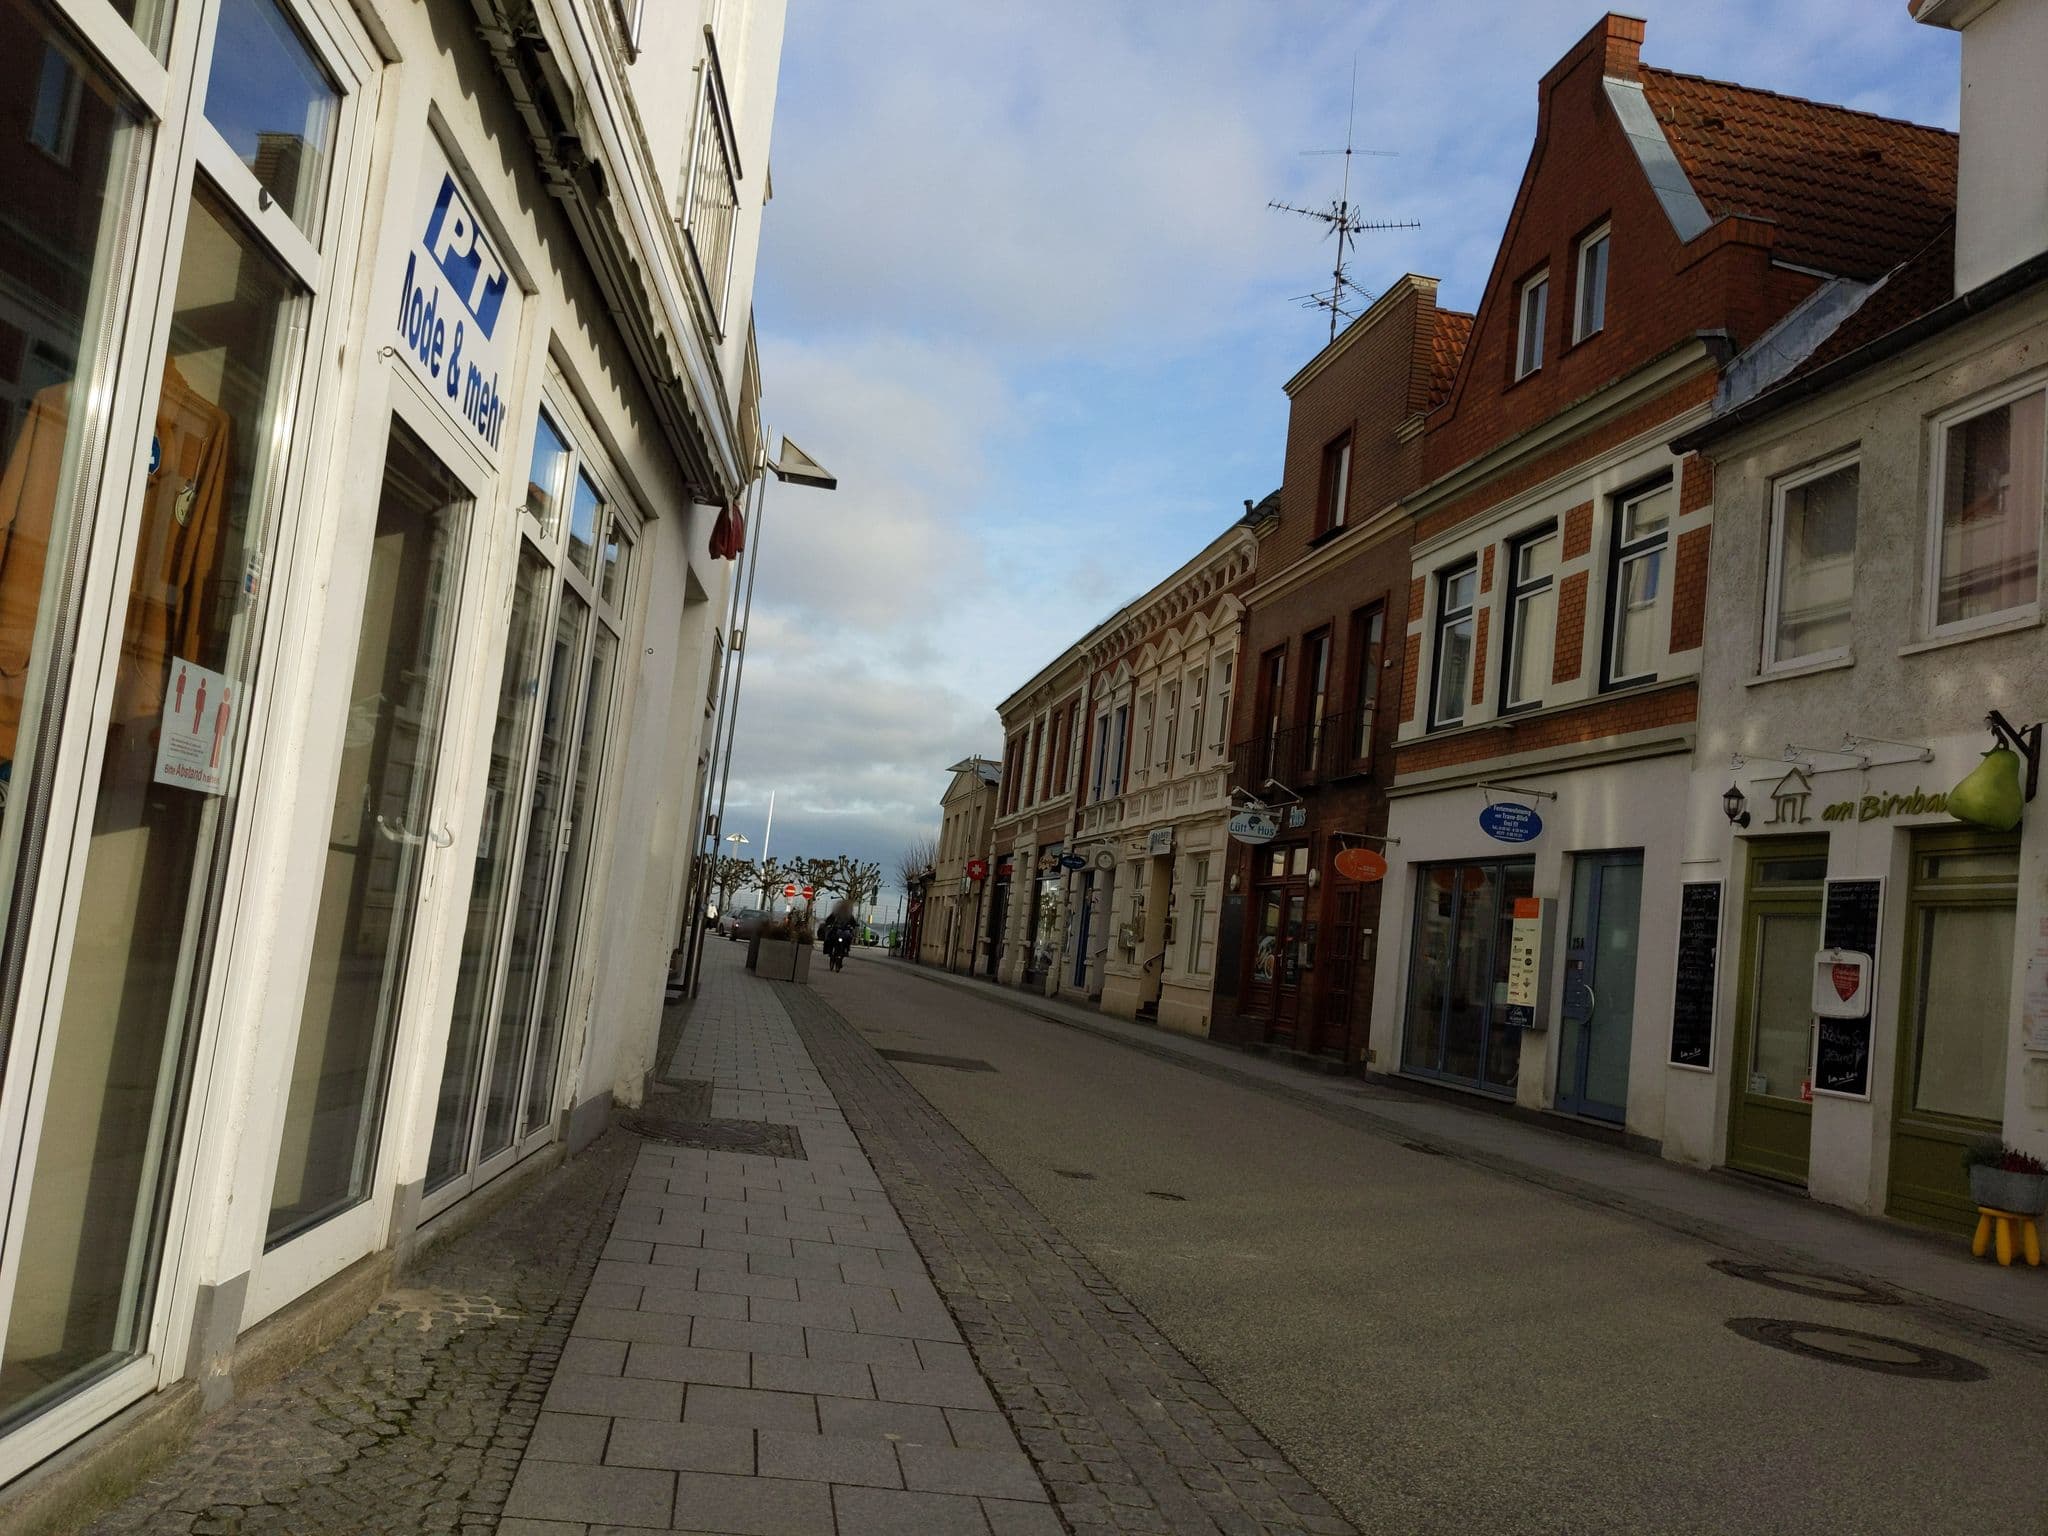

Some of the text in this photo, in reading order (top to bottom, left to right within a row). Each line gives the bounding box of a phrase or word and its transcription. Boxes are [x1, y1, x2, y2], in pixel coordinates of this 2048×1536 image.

[433, 190, 502, 316] PT
[446, 319, 464, 403] &
[463, 360, 506, 453] mehr
[175, 763, 203, 781] Abstand
[1821, 786, 1949, 823] am Birnbau
